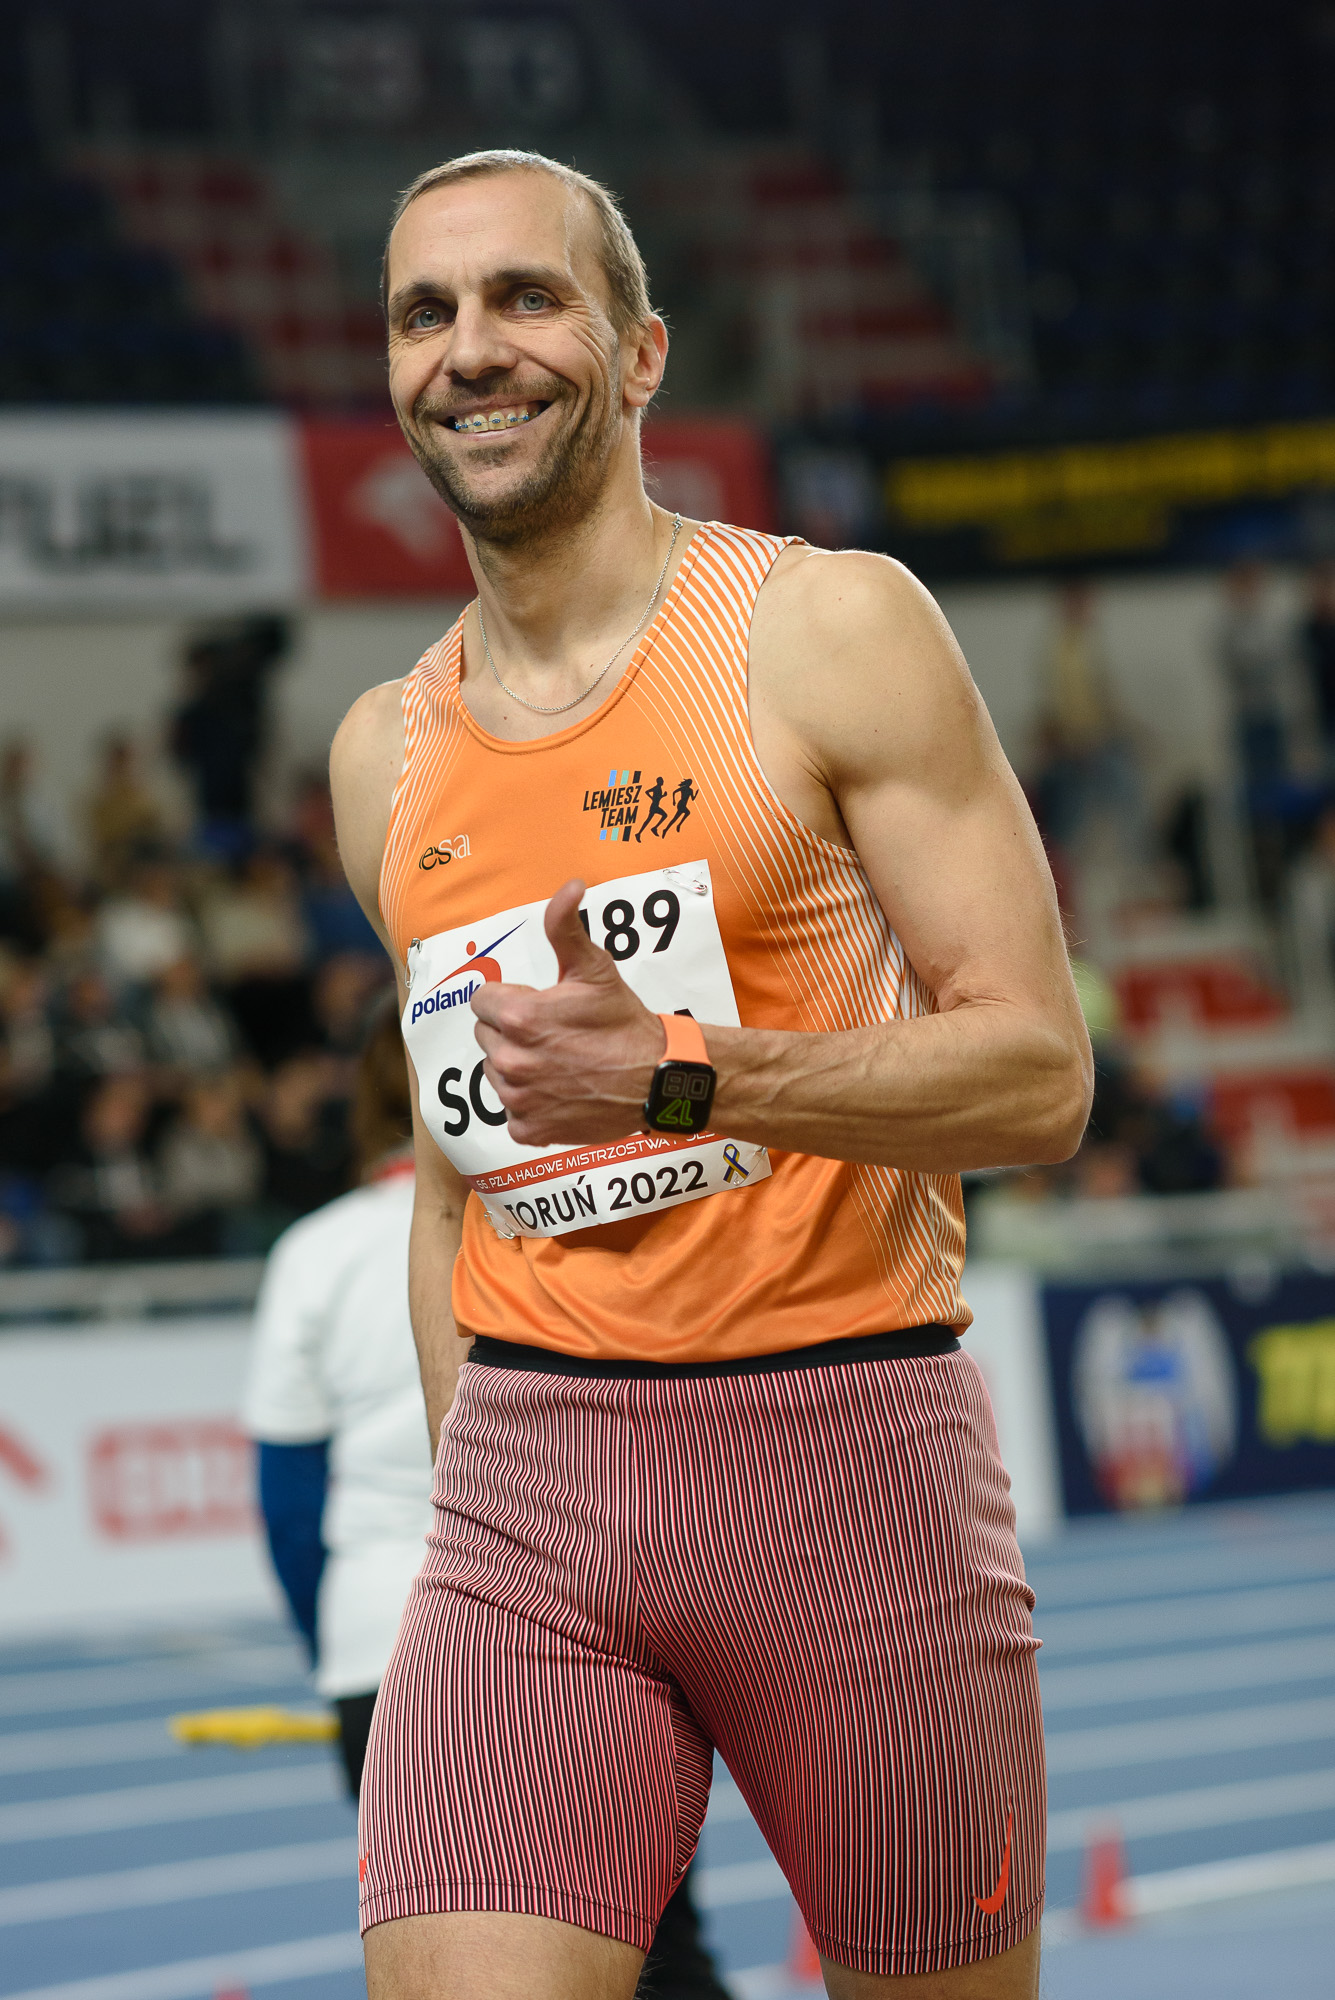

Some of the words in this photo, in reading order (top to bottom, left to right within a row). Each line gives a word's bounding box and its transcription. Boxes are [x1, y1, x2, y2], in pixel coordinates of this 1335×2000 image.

[583, 785, 642, 811] LEMIESZ
[600, 806, 638, 828] TEAM
[419, 834, 472, 870] esa
[490, 1174, 515, 1188] PZLA
[515, 1159, 563, 1182] HALOWE
[566, 1138, 670, 1169] MISTRZOSTWA
[504, 1175, 597, 1230] TORUŃ
[607, 1160, 708, 1211] 2022
